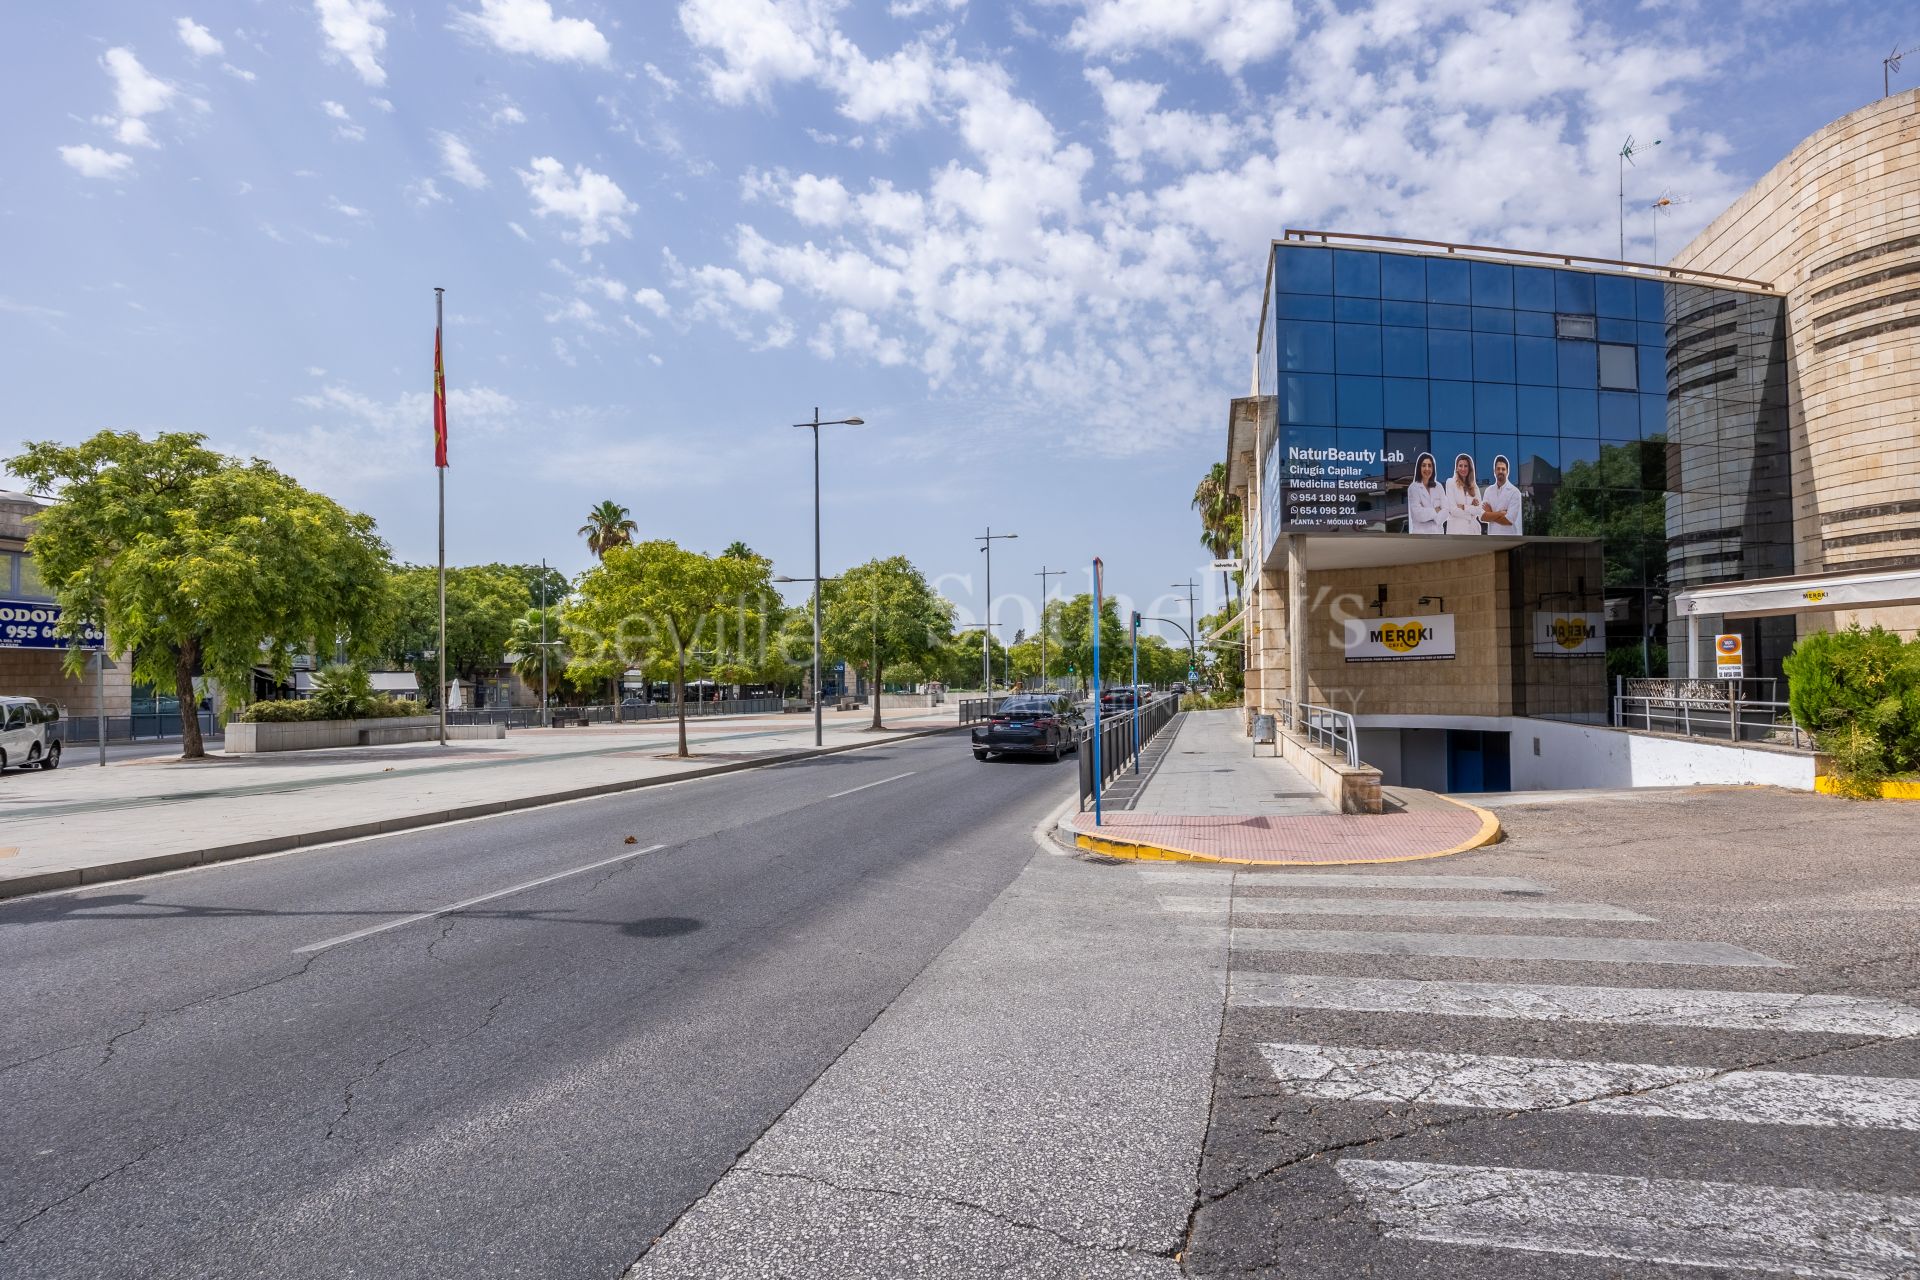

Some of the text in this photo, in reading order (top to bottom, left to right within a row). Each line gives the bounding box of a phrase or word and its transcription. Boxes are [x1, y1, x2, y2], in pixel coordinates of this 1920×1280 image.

[1289, 447, 1404, 464] NaturBeauty Lab
[1289, 465, 1362, 476] Cirugía Capilar
[1290, 479, 1378, 489] Medicina Estética
[1299, 493, 1356, 502] 954 180 840
[1299, 506, 1357, 515] 654 096 201
[1326, 517, 1354, 526] MÓDULO
[1803, 591, 1829, 600] MERAKI
[6, 624, 37, 638] 955
[1370, 627, 1433, 648] MERAKI
